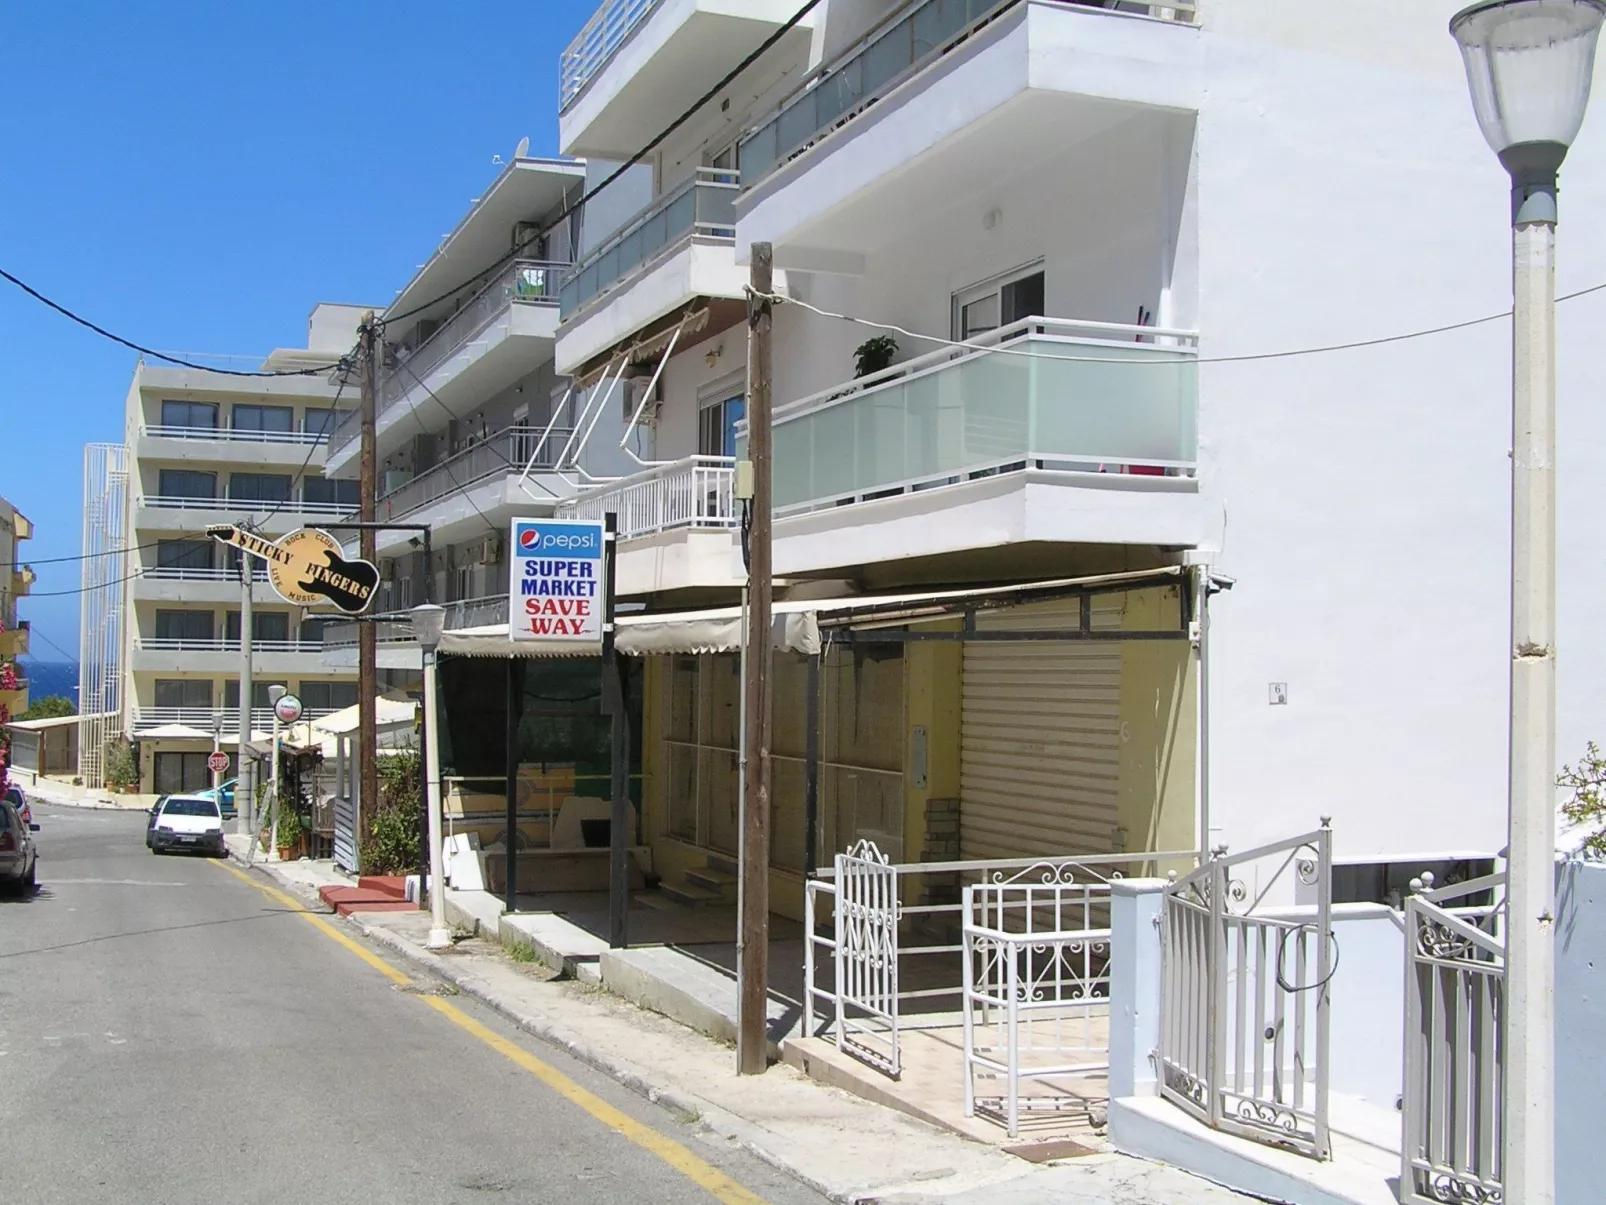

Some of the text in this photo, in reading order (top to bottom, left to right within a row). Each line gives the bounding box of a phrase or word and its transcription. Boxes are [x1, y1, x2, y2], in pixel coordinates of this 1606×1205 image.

[285, 532, 335, 549] ROCK CLUB
[543, 533, 594, 549] pepsi
[238, 533, 370, 599] STICKY FINGERS
[525, 560, 592, 577] SUPER
[271, 568, 316, 602] LIVE MUSIC
[521, 579, 597, 596] MARKET
[525, 598, 590, 616] SAVE
[531, 618, 585, 635] WAY
[210, 756, 227, 767] STOP
